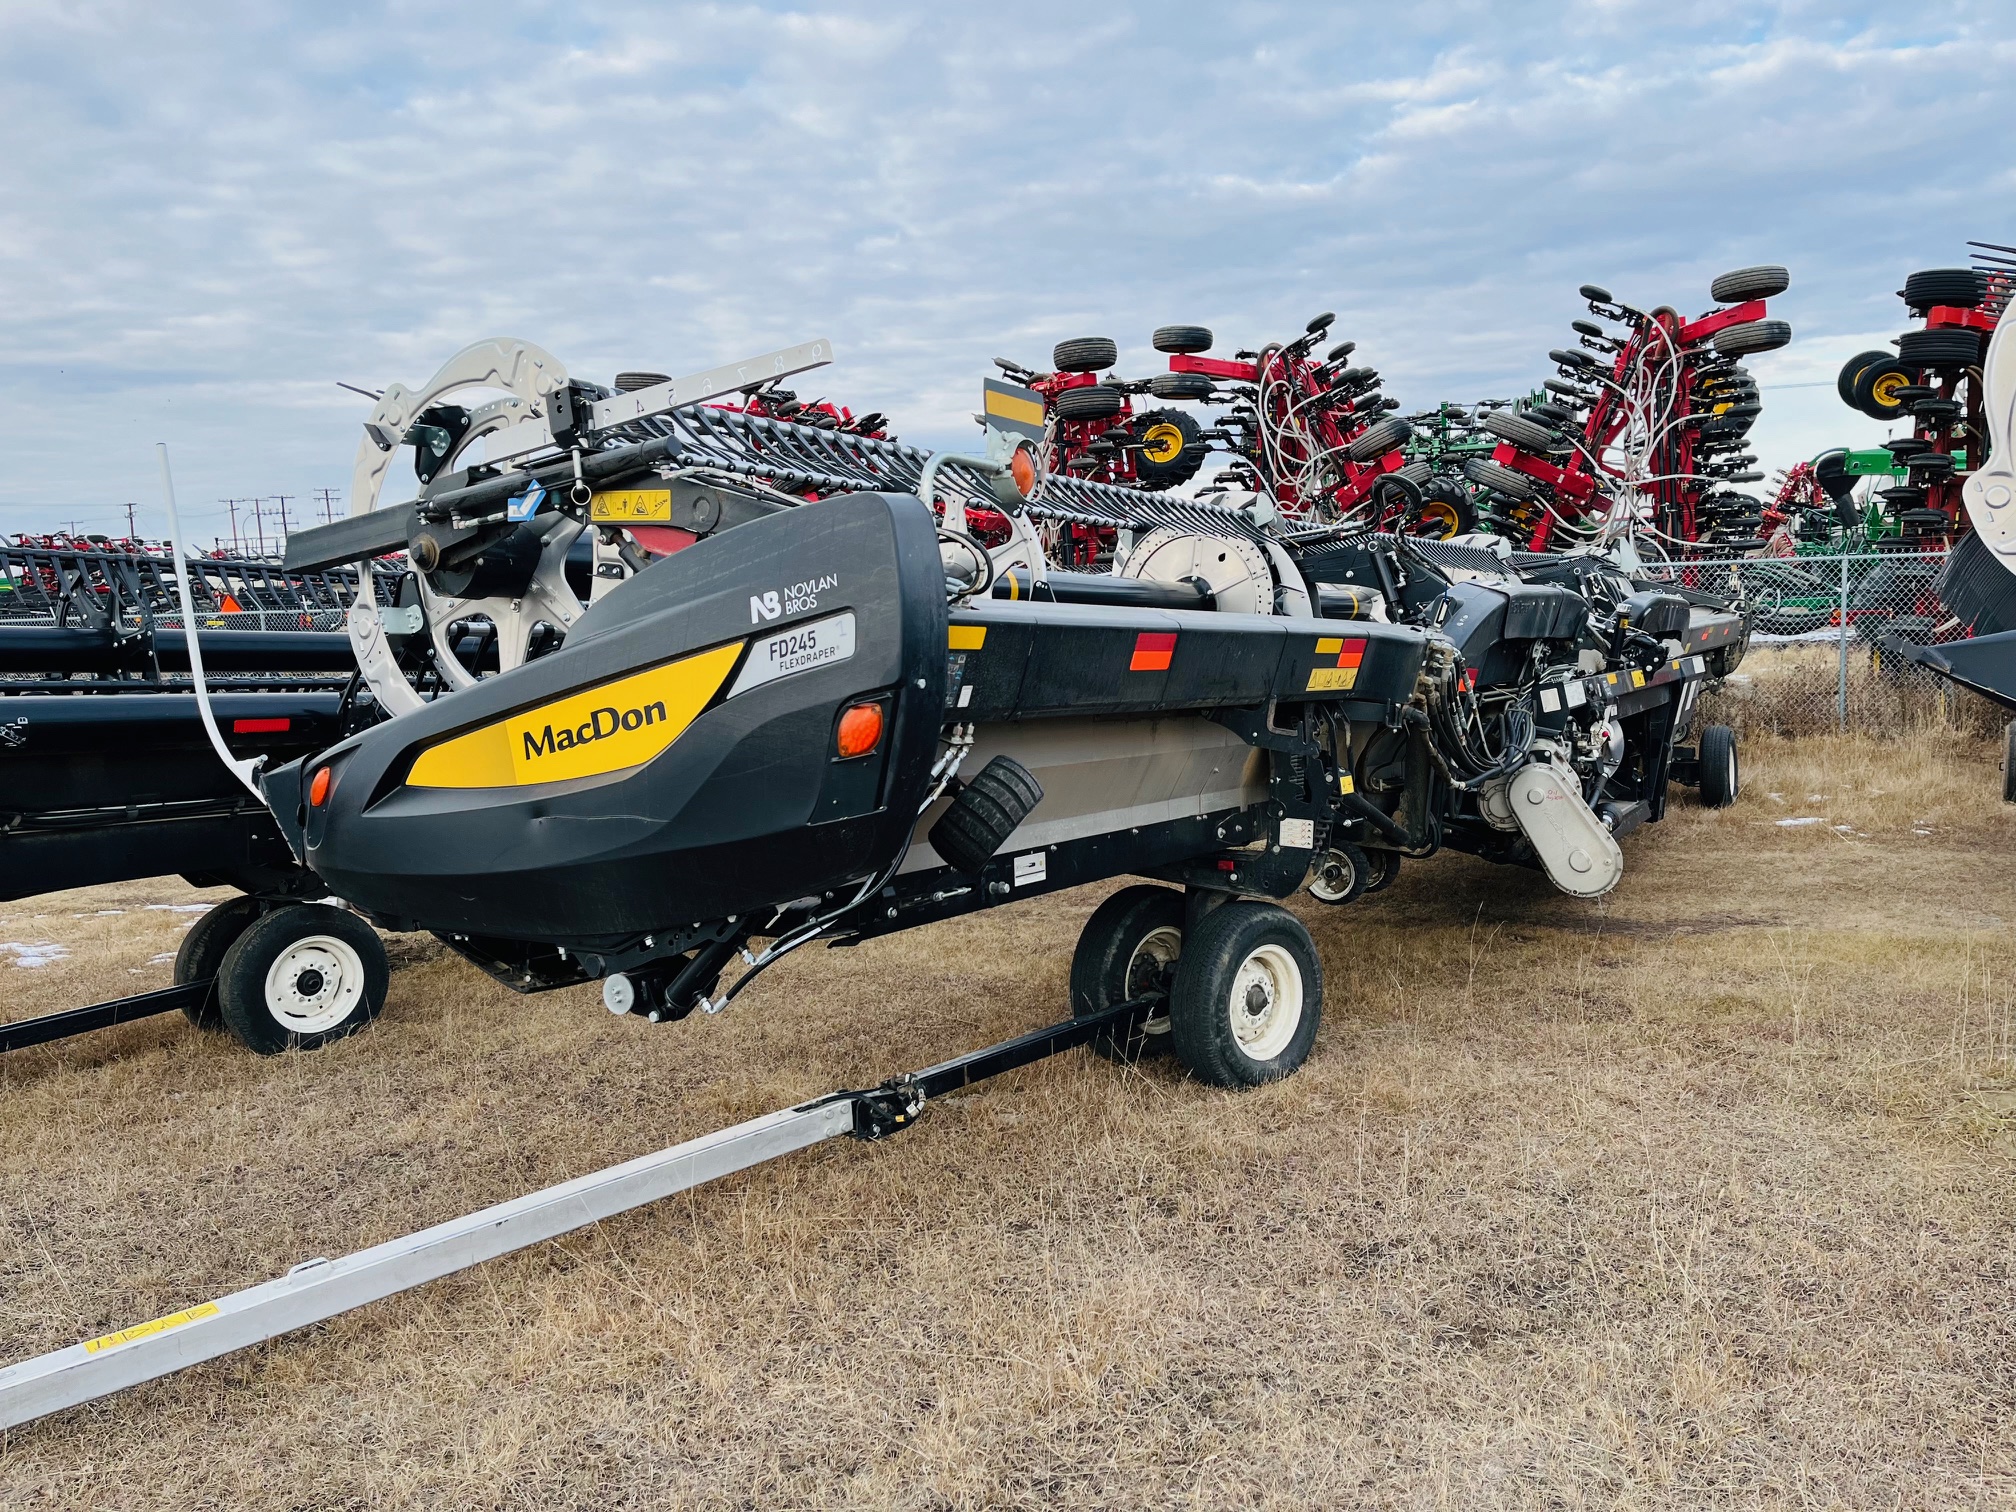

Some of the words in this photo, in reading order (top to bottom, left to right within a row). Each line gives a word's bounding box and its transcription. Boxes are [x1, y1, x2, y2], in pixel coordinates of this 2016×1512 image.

[783, 573, 838, 601] NOVLAN
[785, 594, 818, 615] BROS
[769, 630, 817, 662] FD245
[779, 646, 837, 672] FLEXDRAPER
[522, 700, 668, 761] MacDon
